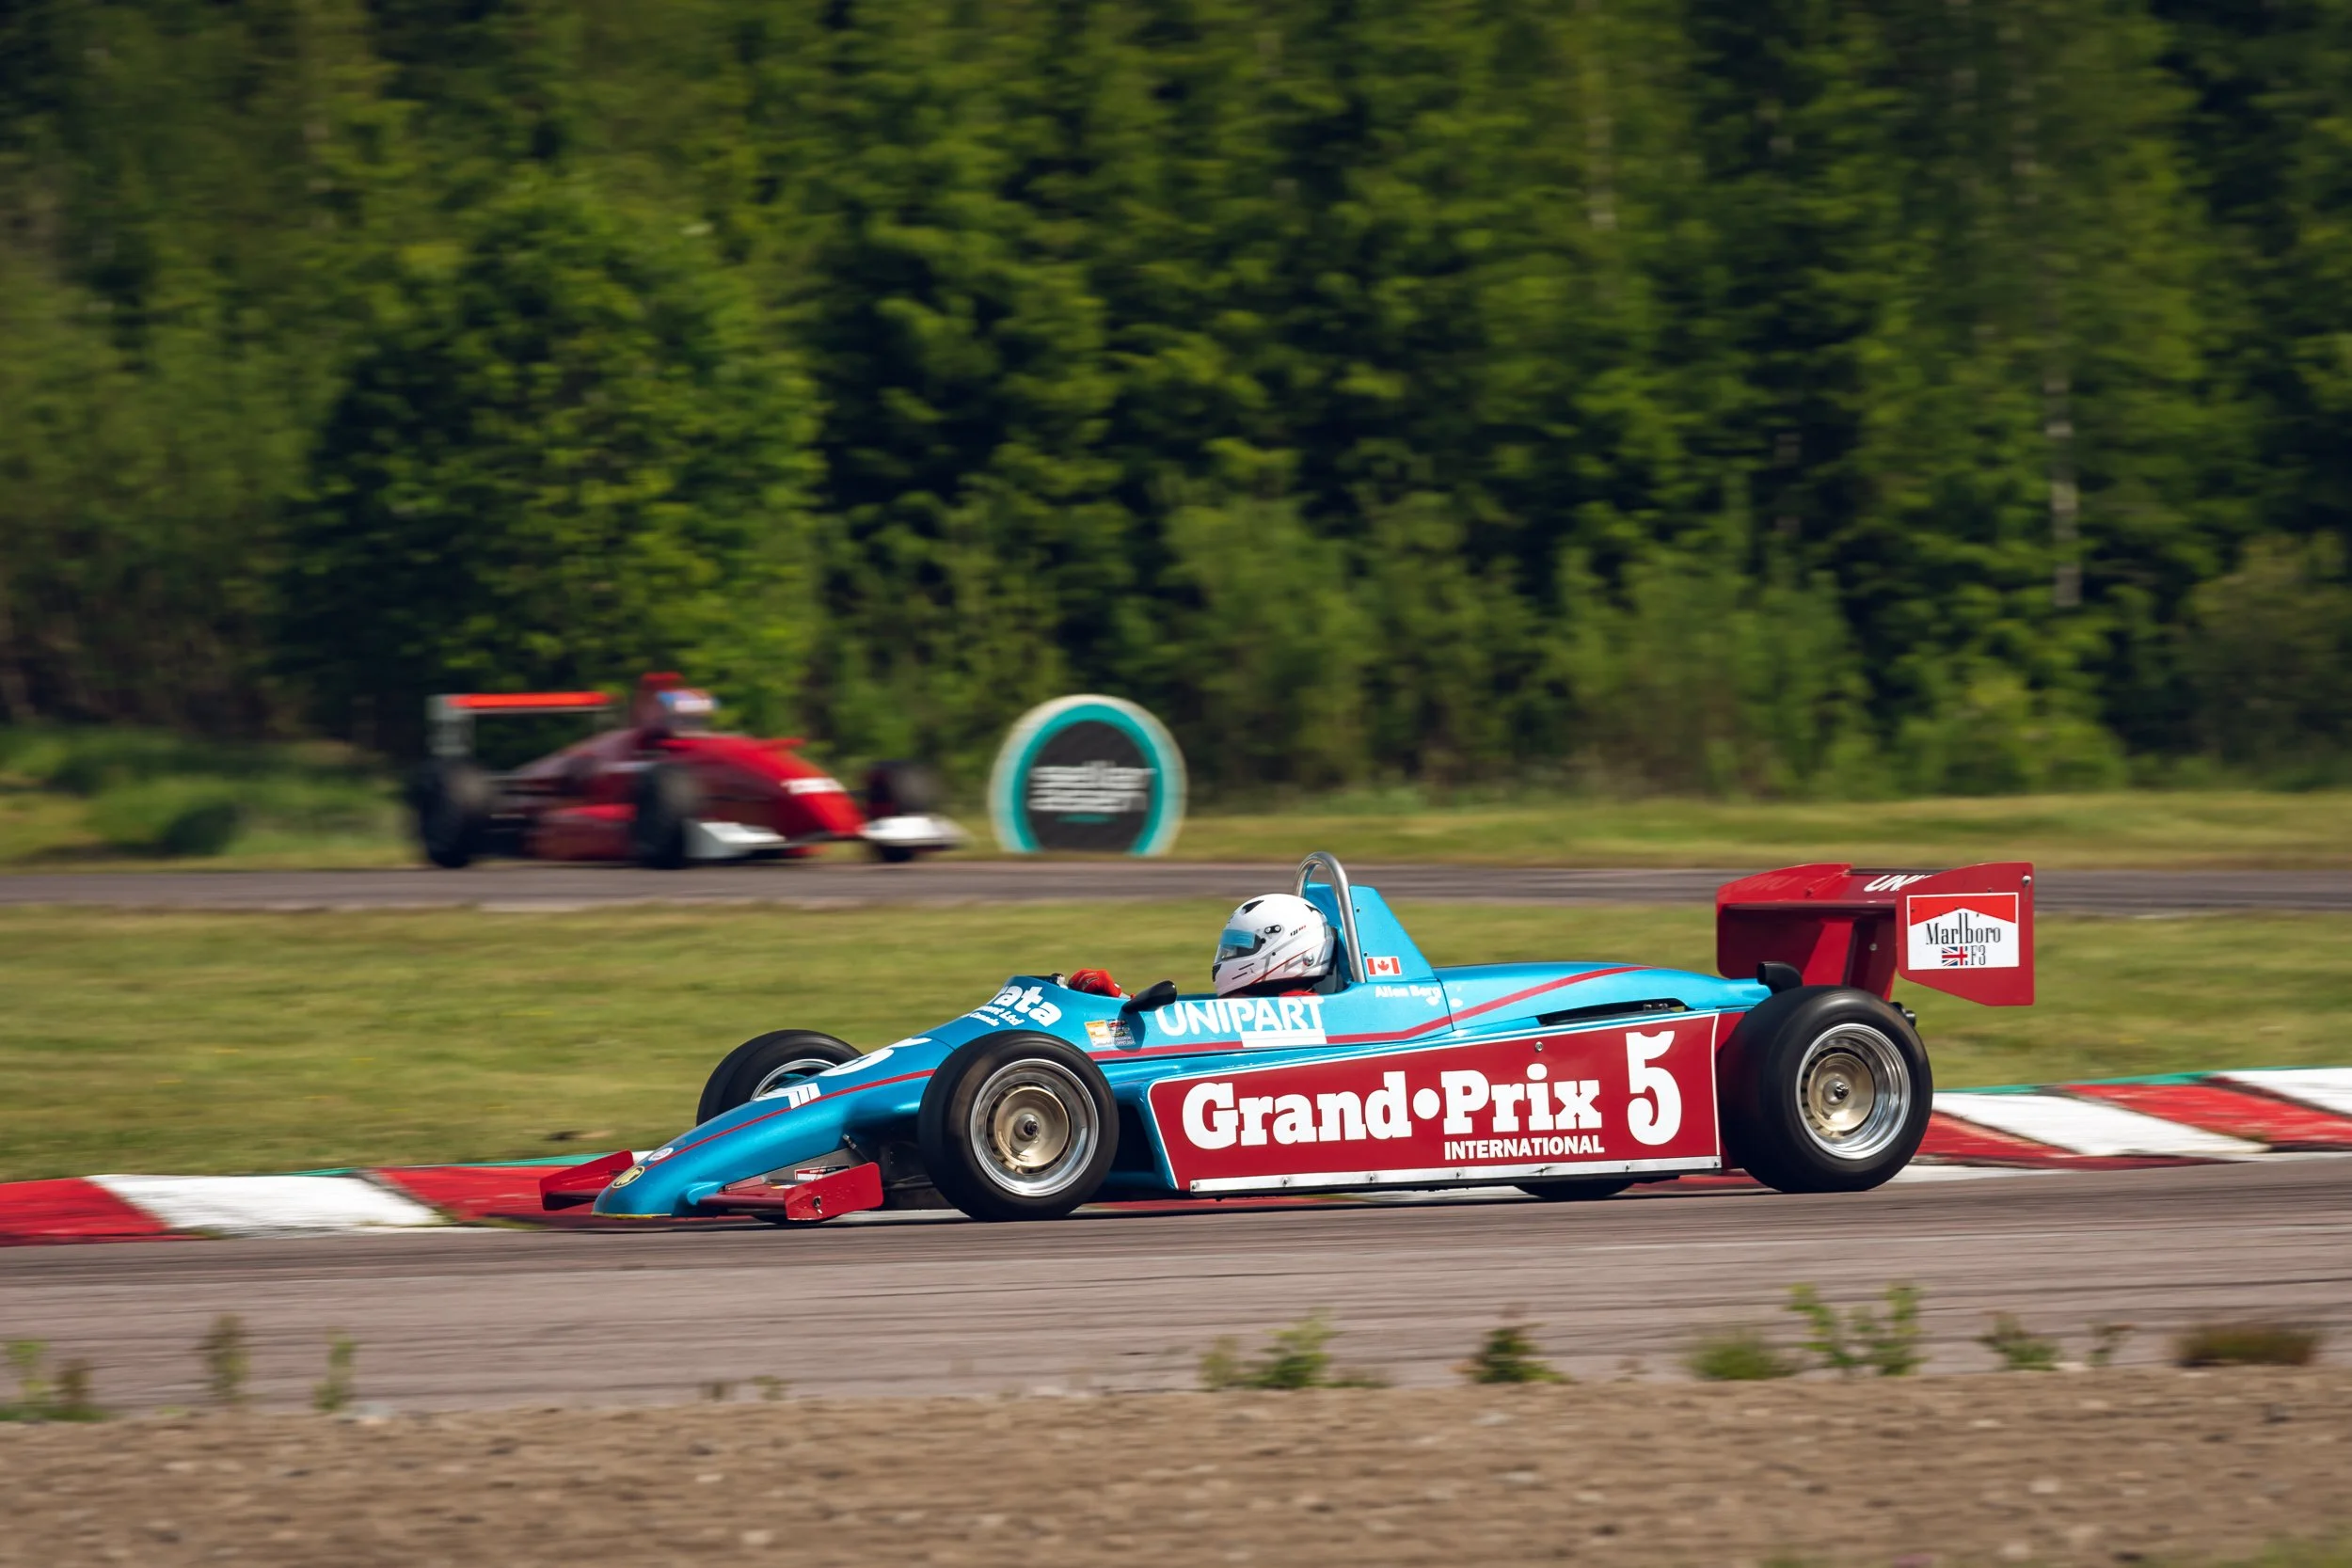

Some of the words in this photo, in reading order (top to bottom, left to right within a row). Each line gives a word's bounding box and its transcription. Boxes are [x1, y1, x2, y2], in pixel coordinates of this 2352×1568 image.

[1926, 912, 2001, 945] Marlboro
[1970, 944, 1986, 966] F3
[999, 1011, 1025, 1026] Ltd
[1155, 997, 1324, 1037] UNIPART
[1626, 1031, 1682, 1146] 5
[1444, 1116, 1605, 1161] INTERNATIONAL
